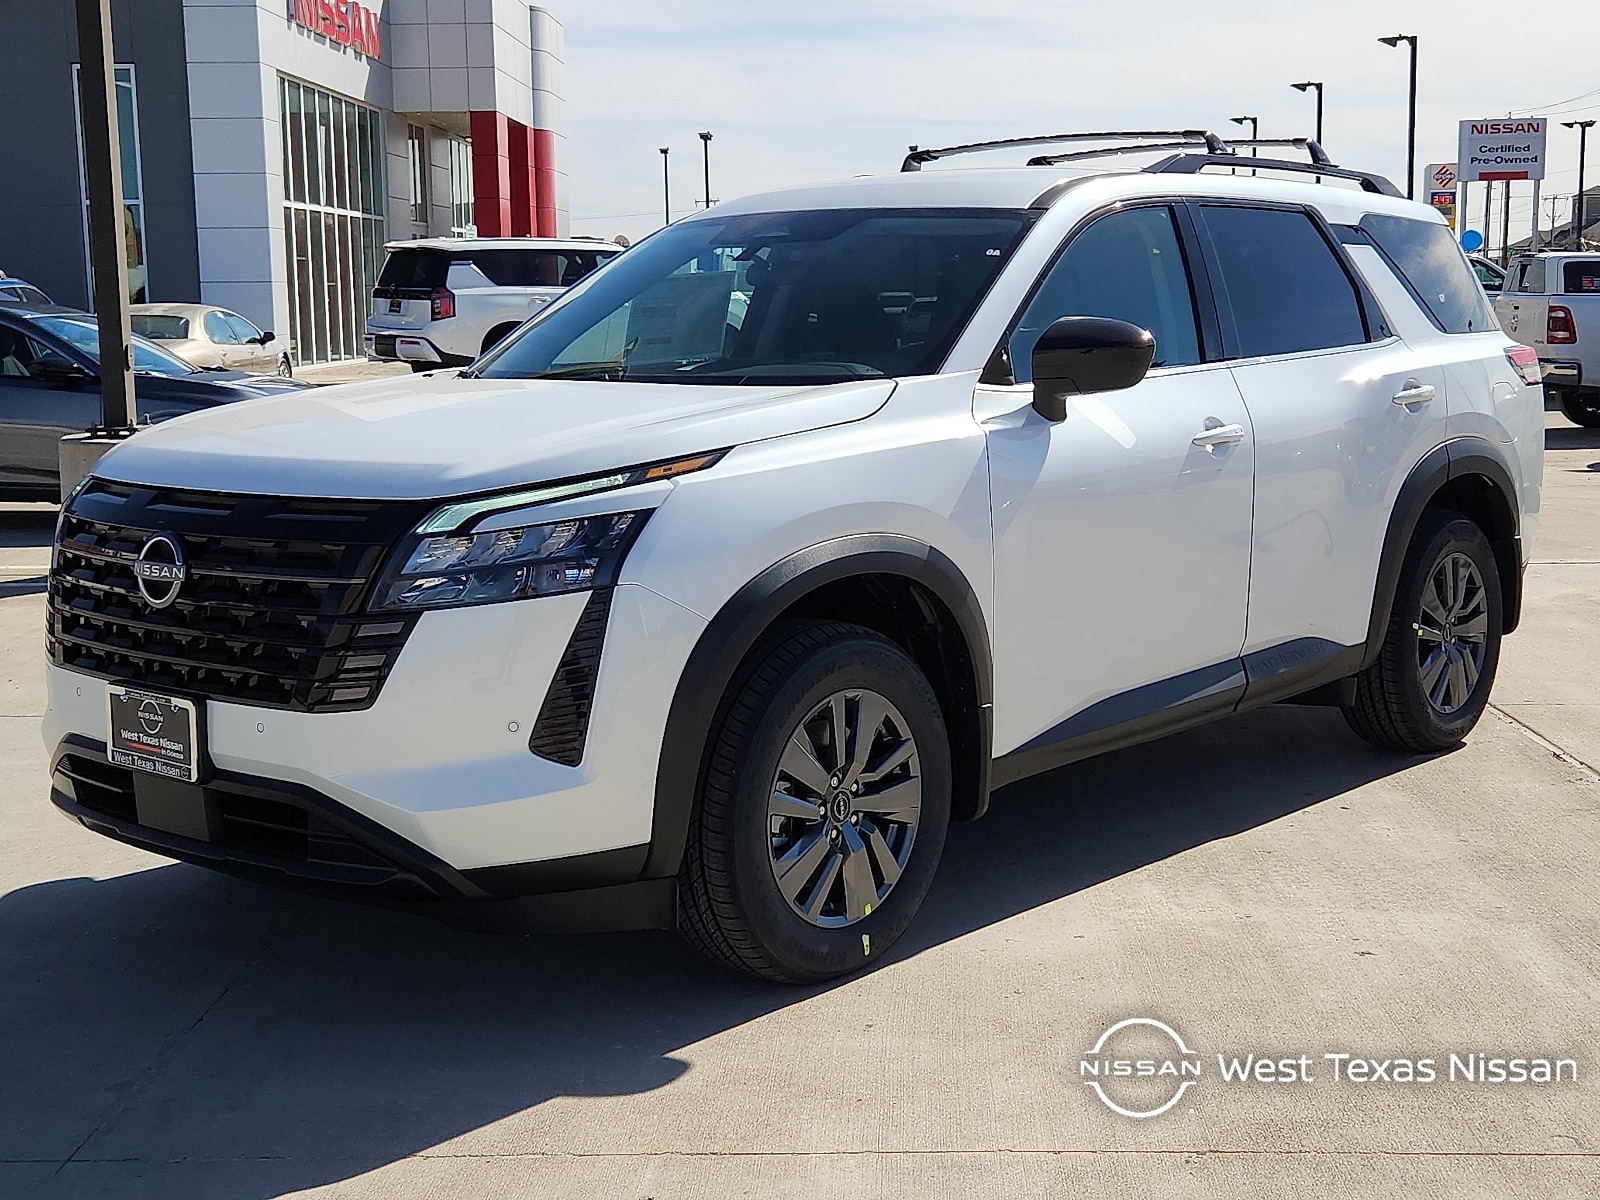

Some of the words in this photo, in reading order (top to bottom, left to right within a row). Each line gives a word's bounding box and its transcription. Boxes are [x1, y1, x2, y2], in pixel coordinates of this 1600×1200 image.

[293, 0, 380, 60] NISSAN
[1471, 122, 1540, 135] NISSAN
[1478, 144, 1531, 154] Certified
[1470, 155, 1538, 165] Pre-Owned
[134, 561, 184, 581] NISSAN
[137, 710, 164, 722] NISSAN
[120, 728, 139, 741] West
[139, 733, 160, 746] Texas
[160, 737, 184, 752] Nissan
[113, 751, 133, 765] West
[133, 755, 155, 770] Texas
[155, 761, 180, 777] Nissan
